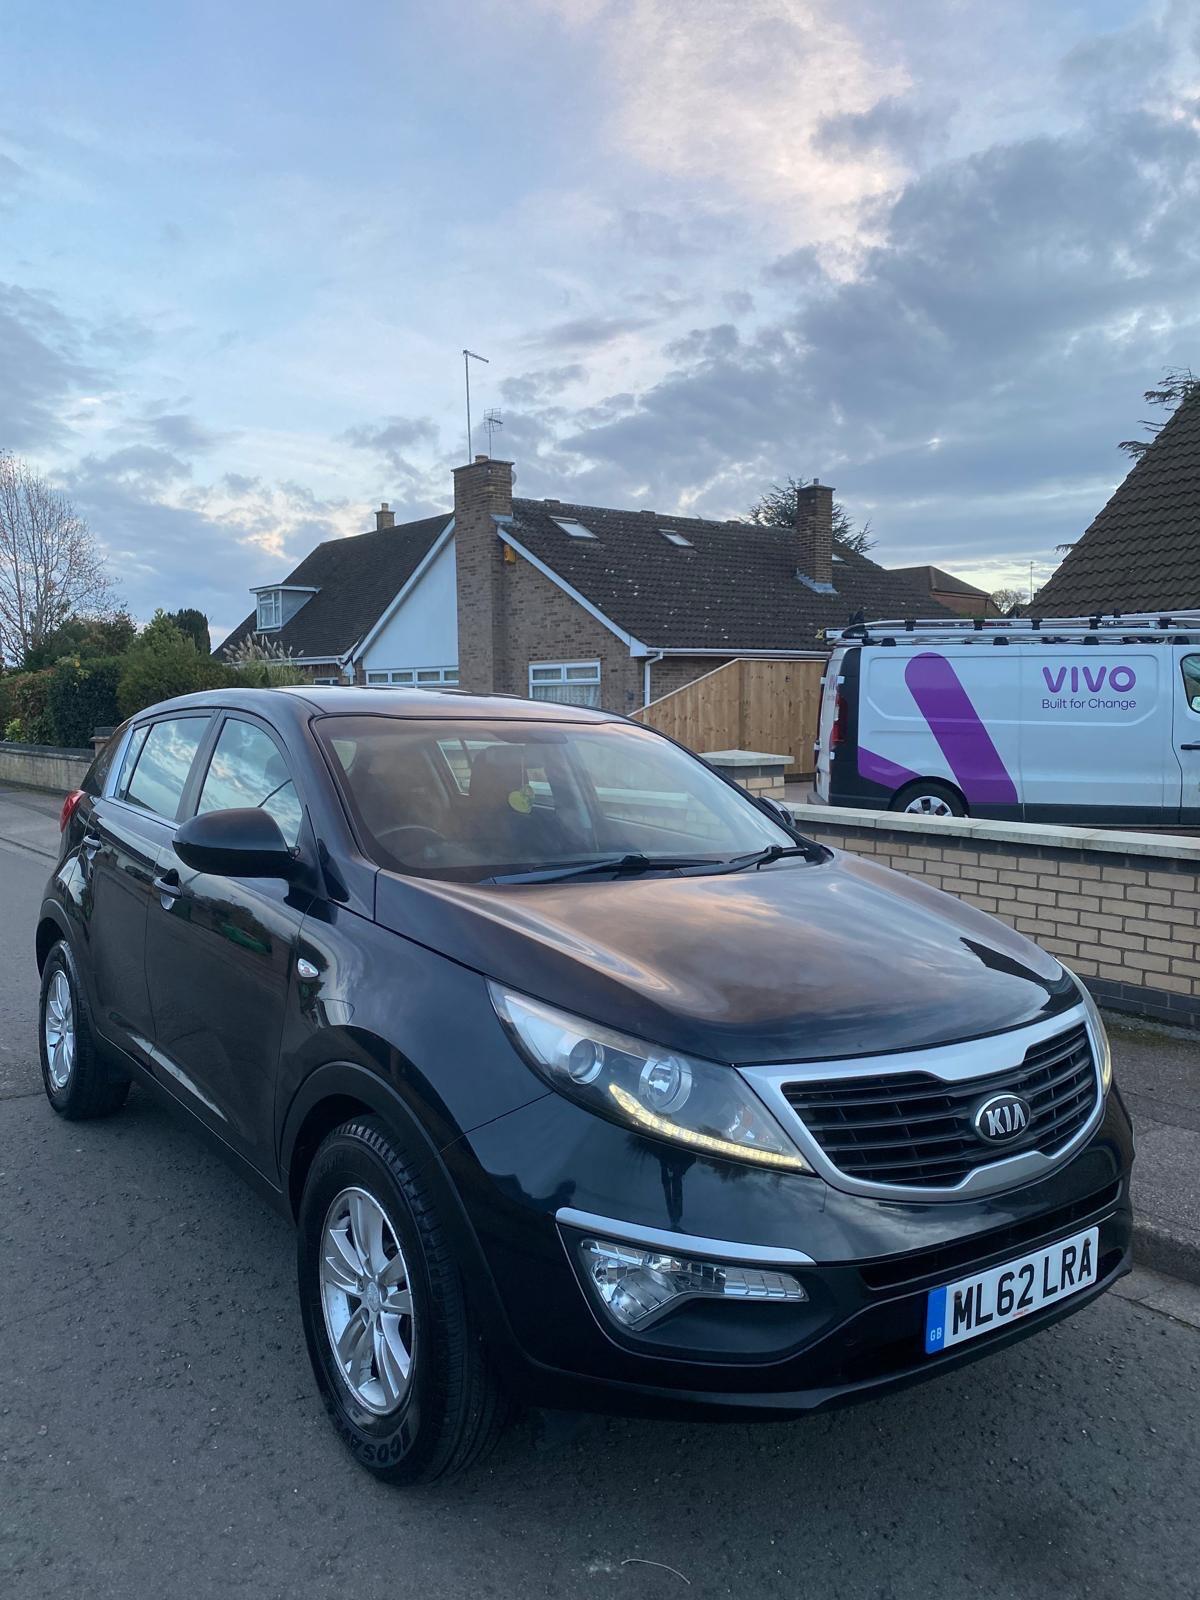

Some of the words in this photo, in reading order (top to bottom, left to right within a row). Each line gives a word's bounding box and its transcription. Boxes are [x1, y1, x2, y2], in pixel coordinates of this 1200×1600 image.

[1042, 666, 1137, 693] VIVO
[1042, 698, 1067, 709] Built
[1069, 698, 1086, 709] for
[1088, 698, 1137, 711] Change
[985, 1103, 1026, 1137] KIA
[952, 1263, 1035, 1336] ML62
[1042, 1239, 1092, 1299] LRA
[930, 1327, 942, 1342] GB
